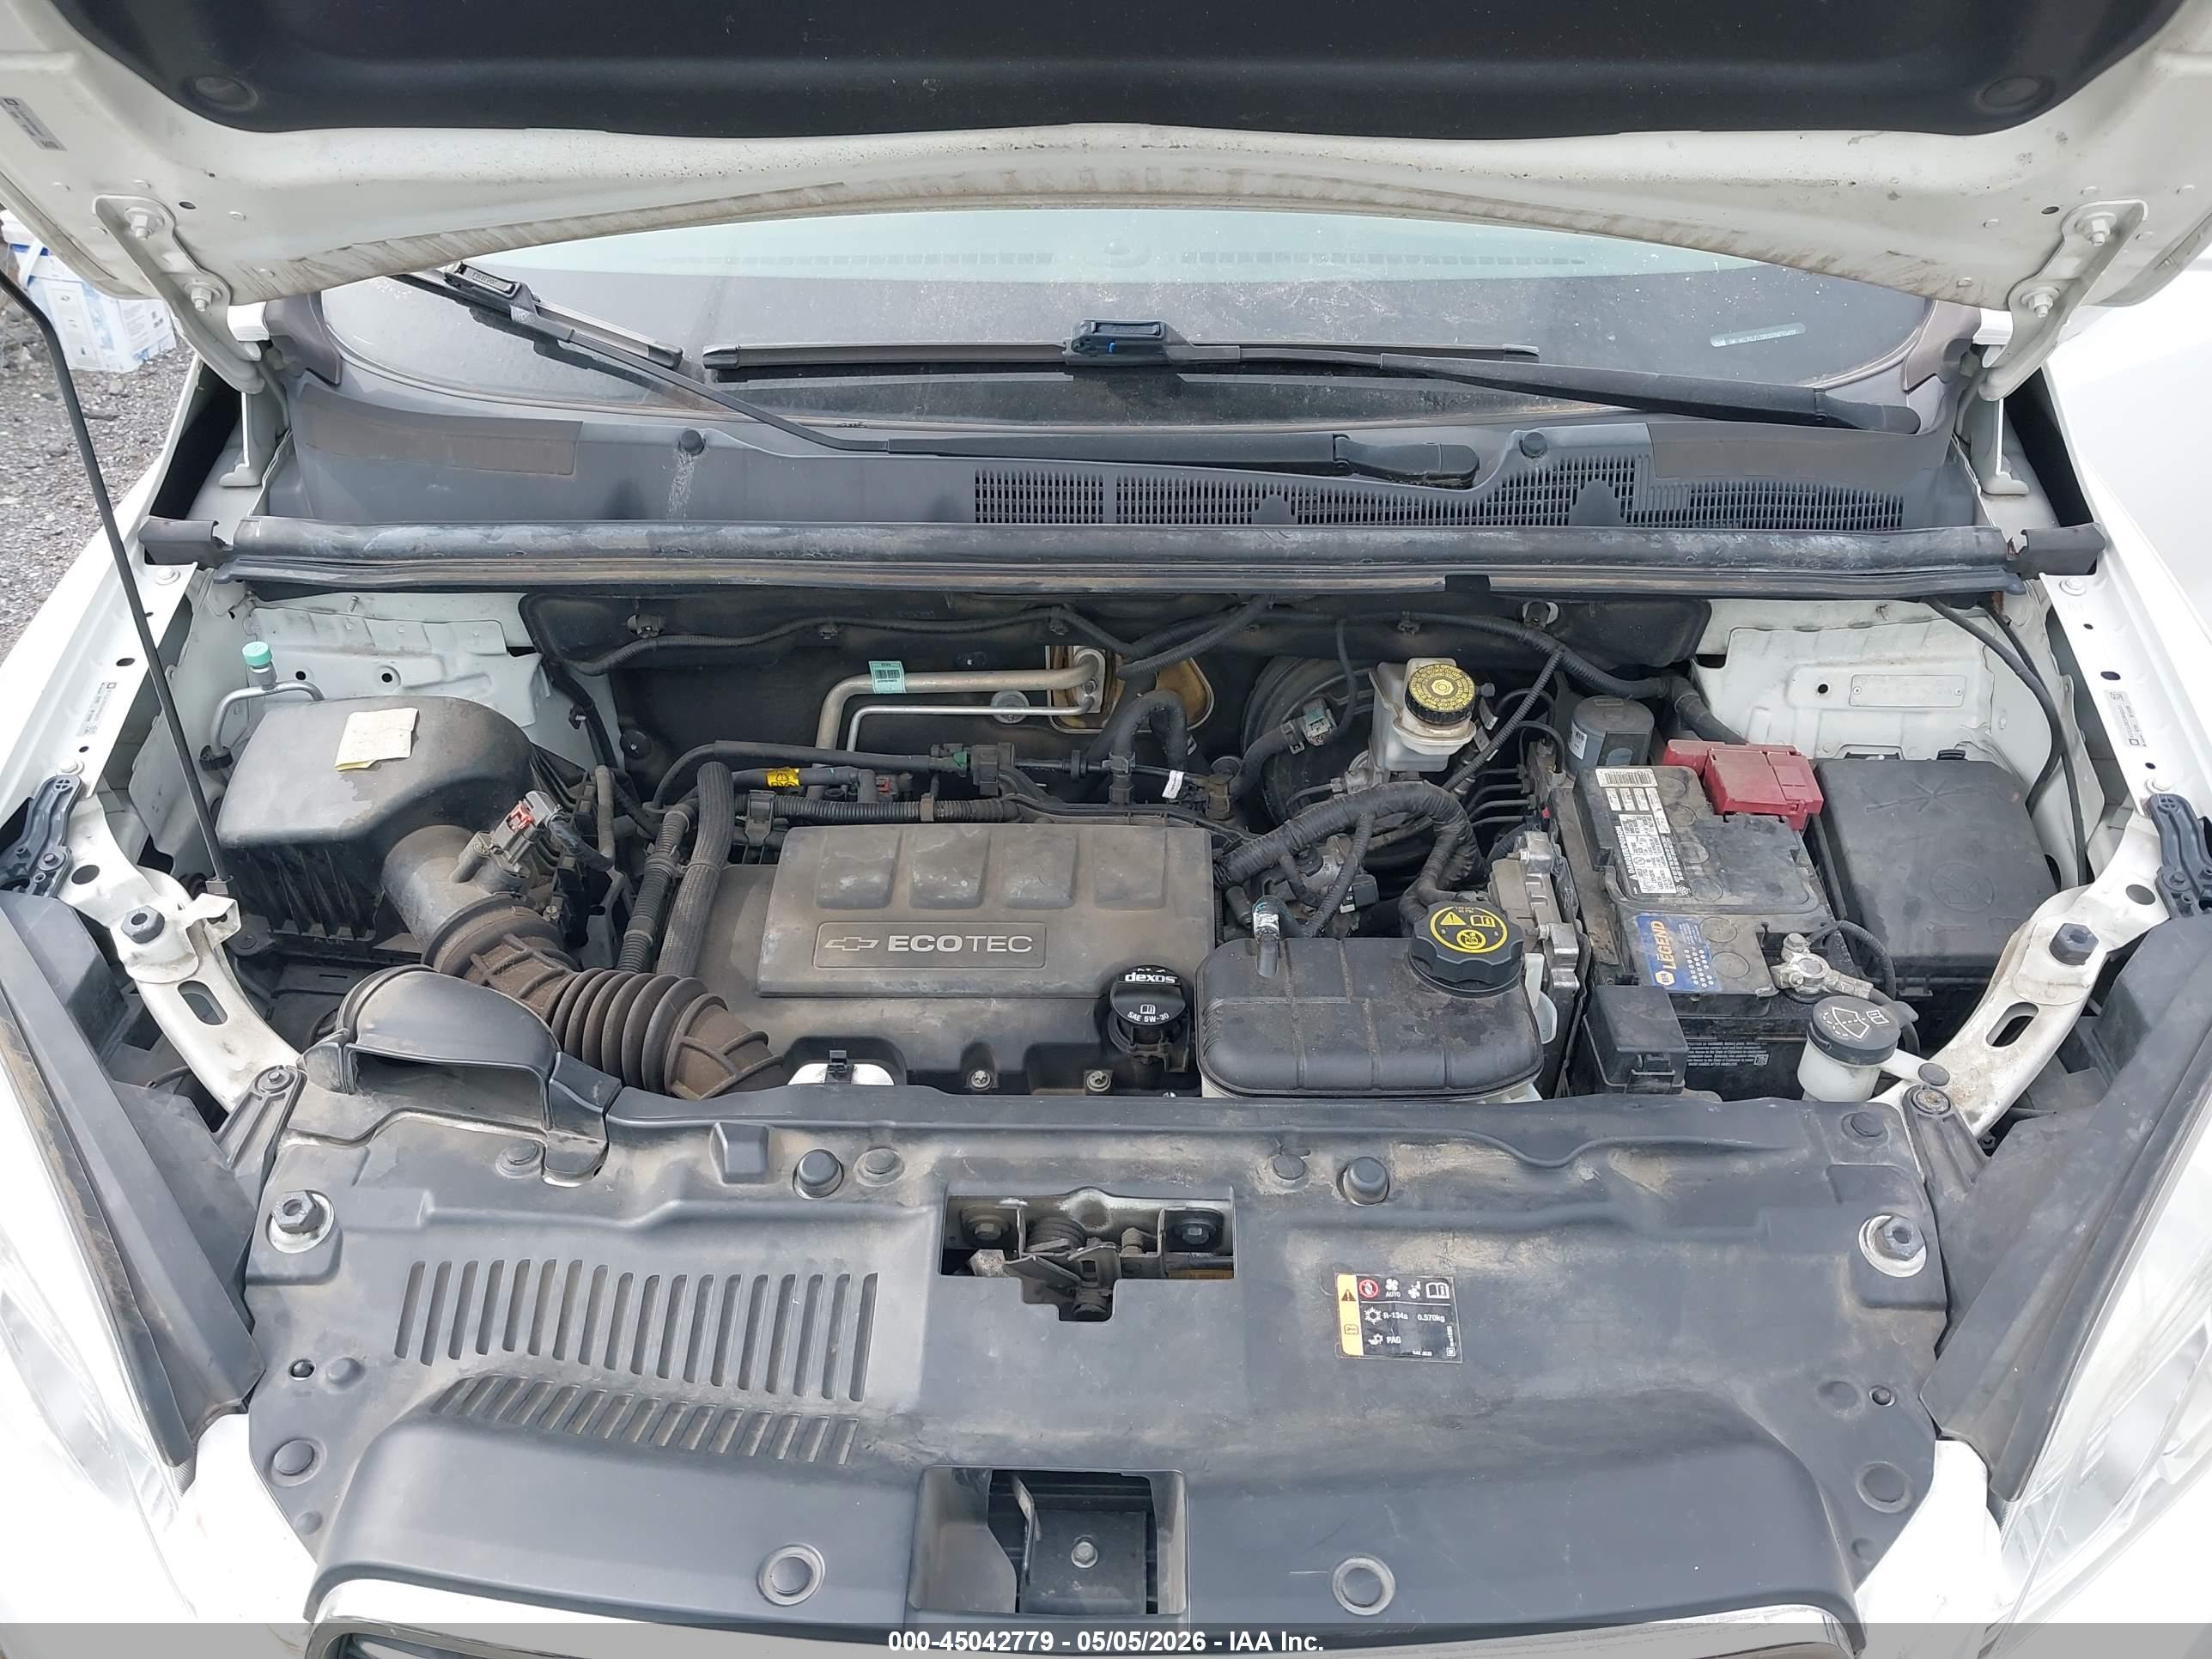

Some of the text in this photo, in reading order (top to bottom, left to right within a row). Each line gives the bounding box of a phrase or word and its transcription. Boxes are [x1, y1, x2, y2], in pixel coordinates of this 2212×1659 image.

[887, 934, 1033, 953] ECOTEC
[1125, 972, 1178, 983] dexos
[1127, 1012, 1170, 1023] SAE 5W-30
[1382, 1311, 1445, 1322] R-134a 0.570kg
